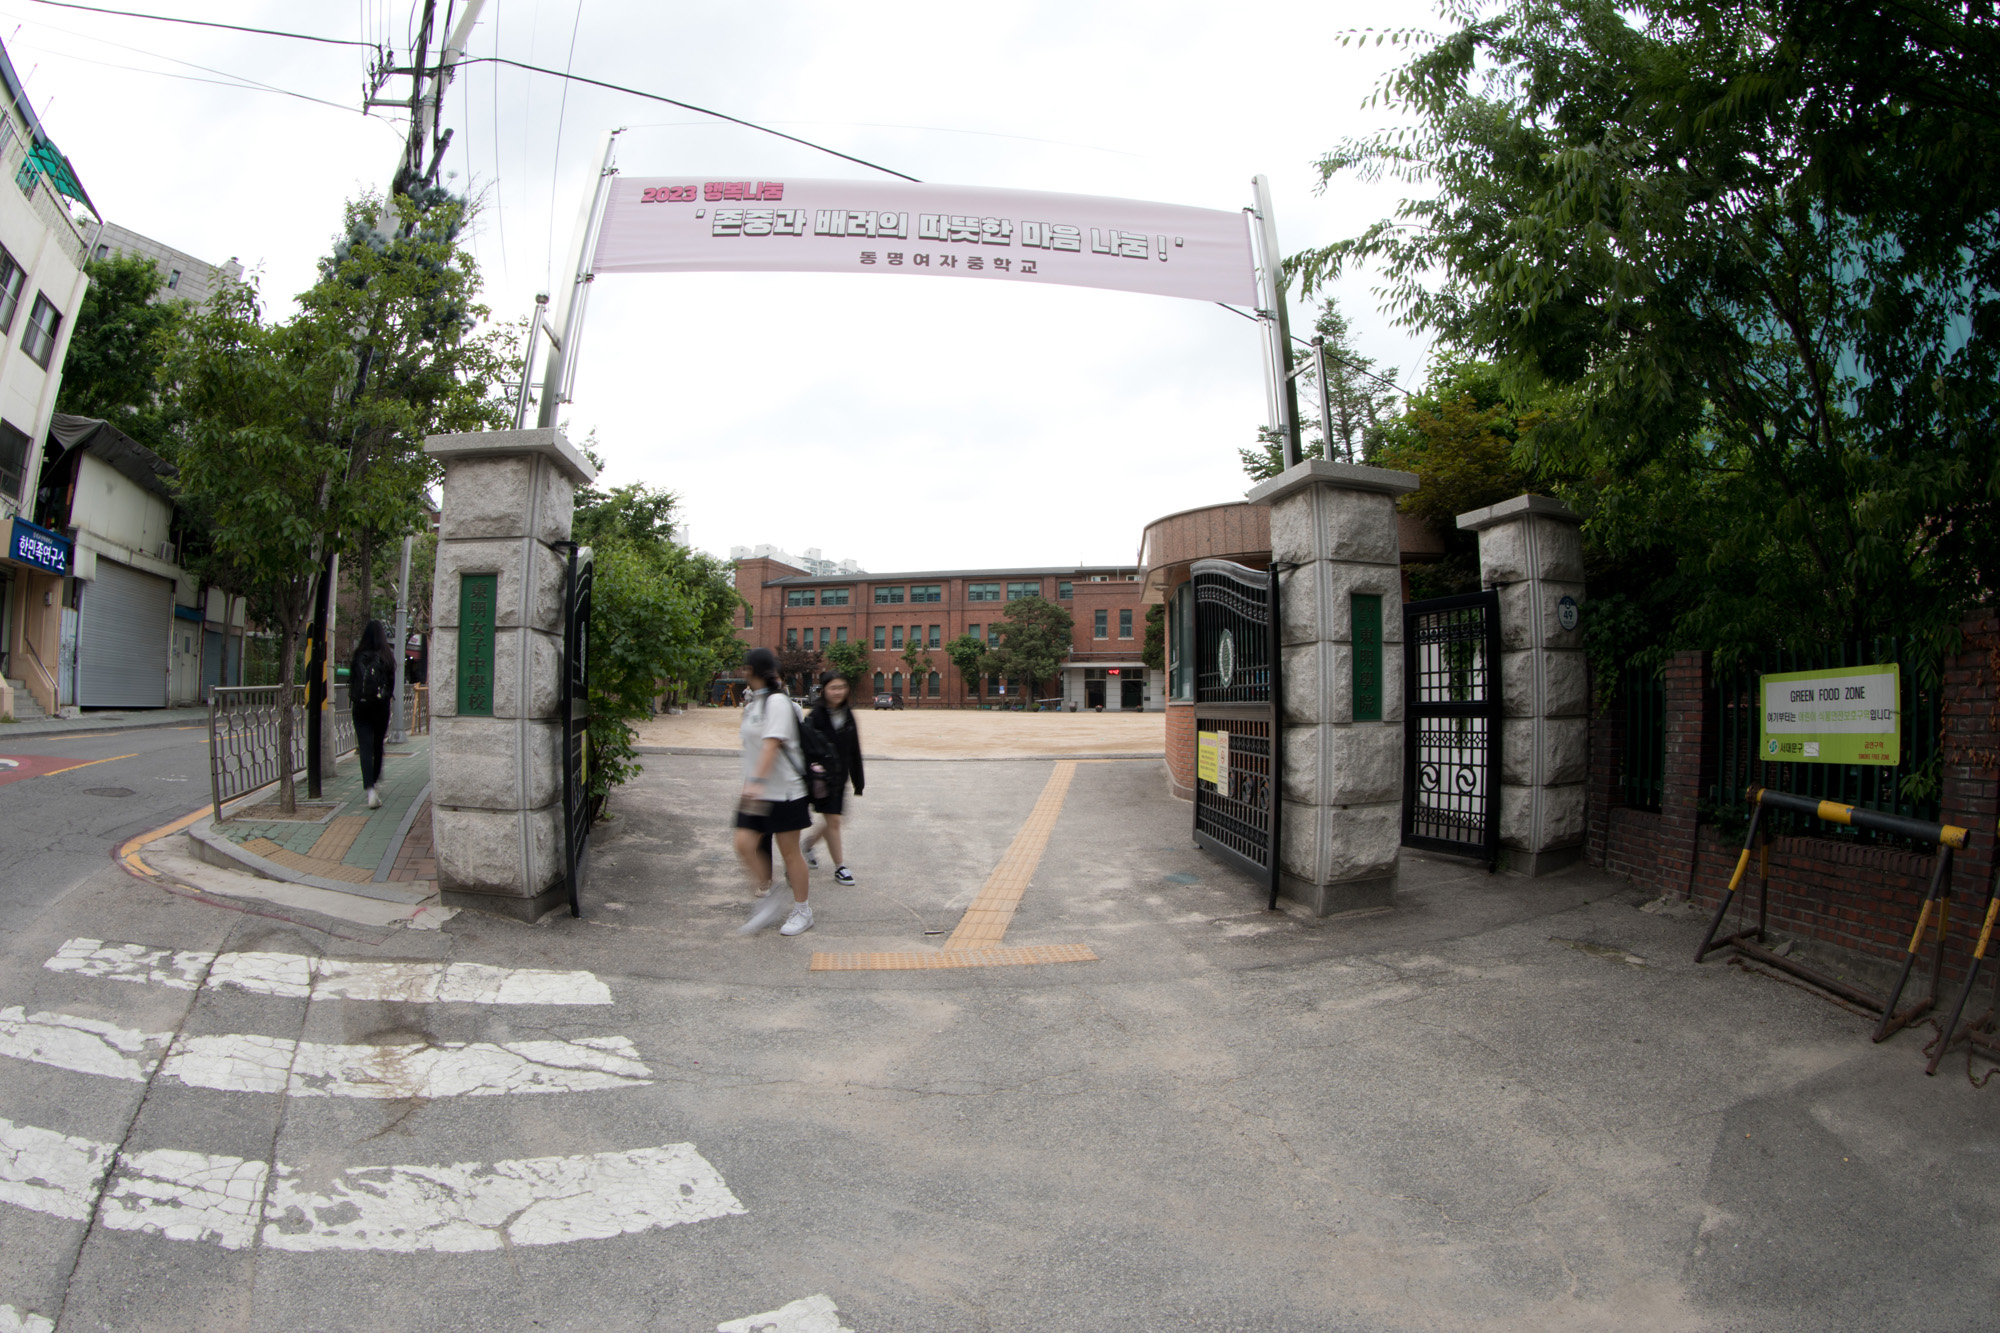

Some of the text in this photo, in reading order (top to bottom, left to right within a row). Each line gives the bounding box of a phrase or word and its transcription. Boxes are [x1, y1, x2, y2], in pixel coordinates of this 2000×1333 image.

[641, 181, 784, 203] 2023 행복나눔
[814, 209, 909, 239] 배려의
[919, 213, 1013, 246] 따뜻한
[1021, 220, 1081, 253] 마음
[19, 535, 65, 570] 한민족연구소
[1563, 610, 1573, 620] 49
[468, 583, 488, 710] 東明女子中學校
[1790, 686, 1865, 702] GREEN FOOD ZONE
[1767, 712, 1796, 723] 여기부터는
[1780, 742, 1803, 753] 서대문구
